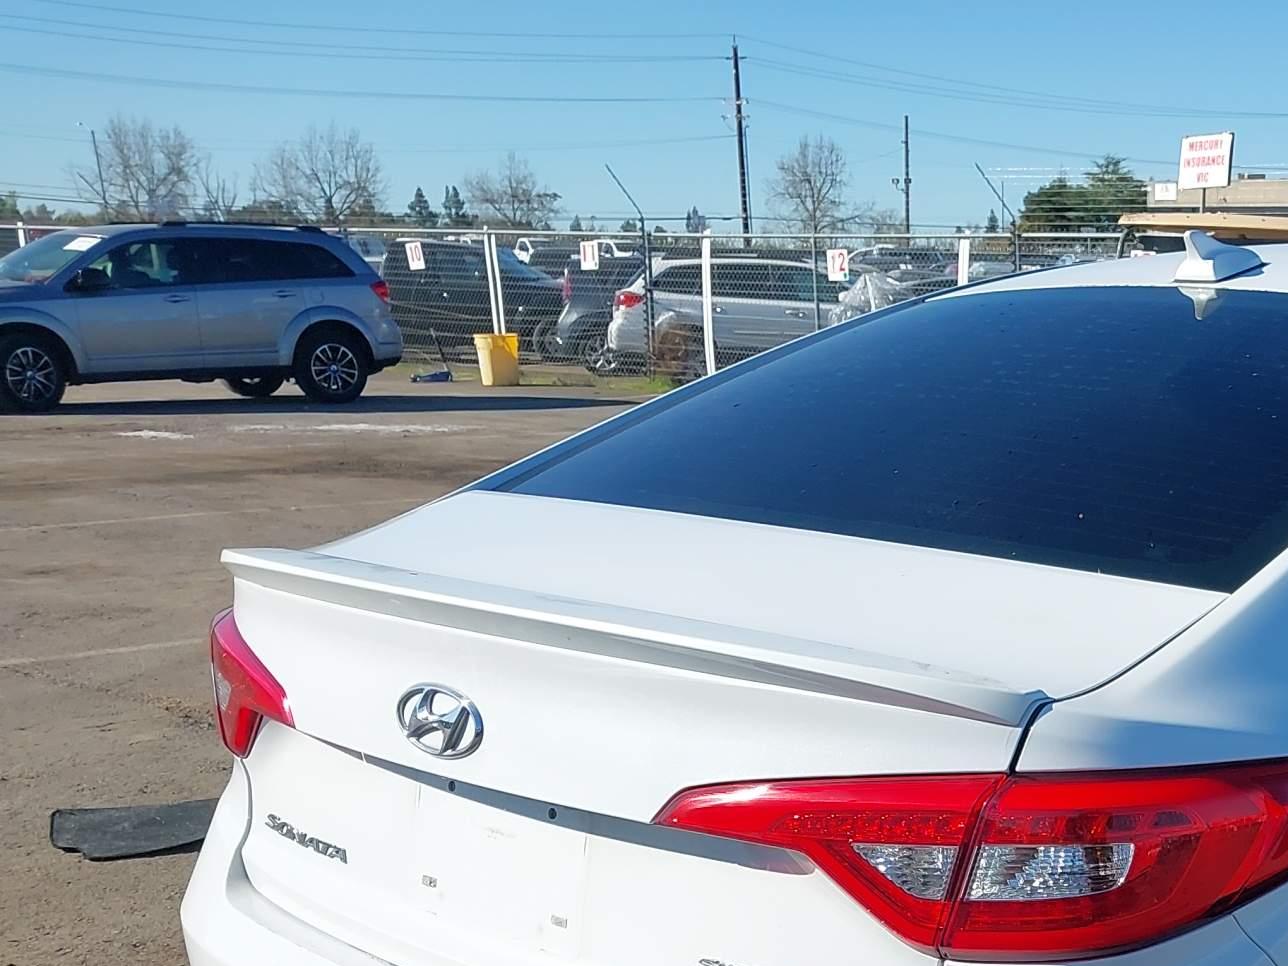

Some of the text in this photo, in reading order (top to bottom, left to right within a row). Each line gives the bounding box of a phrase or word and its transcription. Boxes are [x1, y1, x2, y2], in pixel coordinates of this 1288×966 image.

[1189, 140, 1223, 152] MERCURY
[1184, 155, 1225, 168] INSURANCE
[409, 245, 422, 262] 10
[831, 252, 846, 273] 12
[264, 813, 348, 865] SONATA
